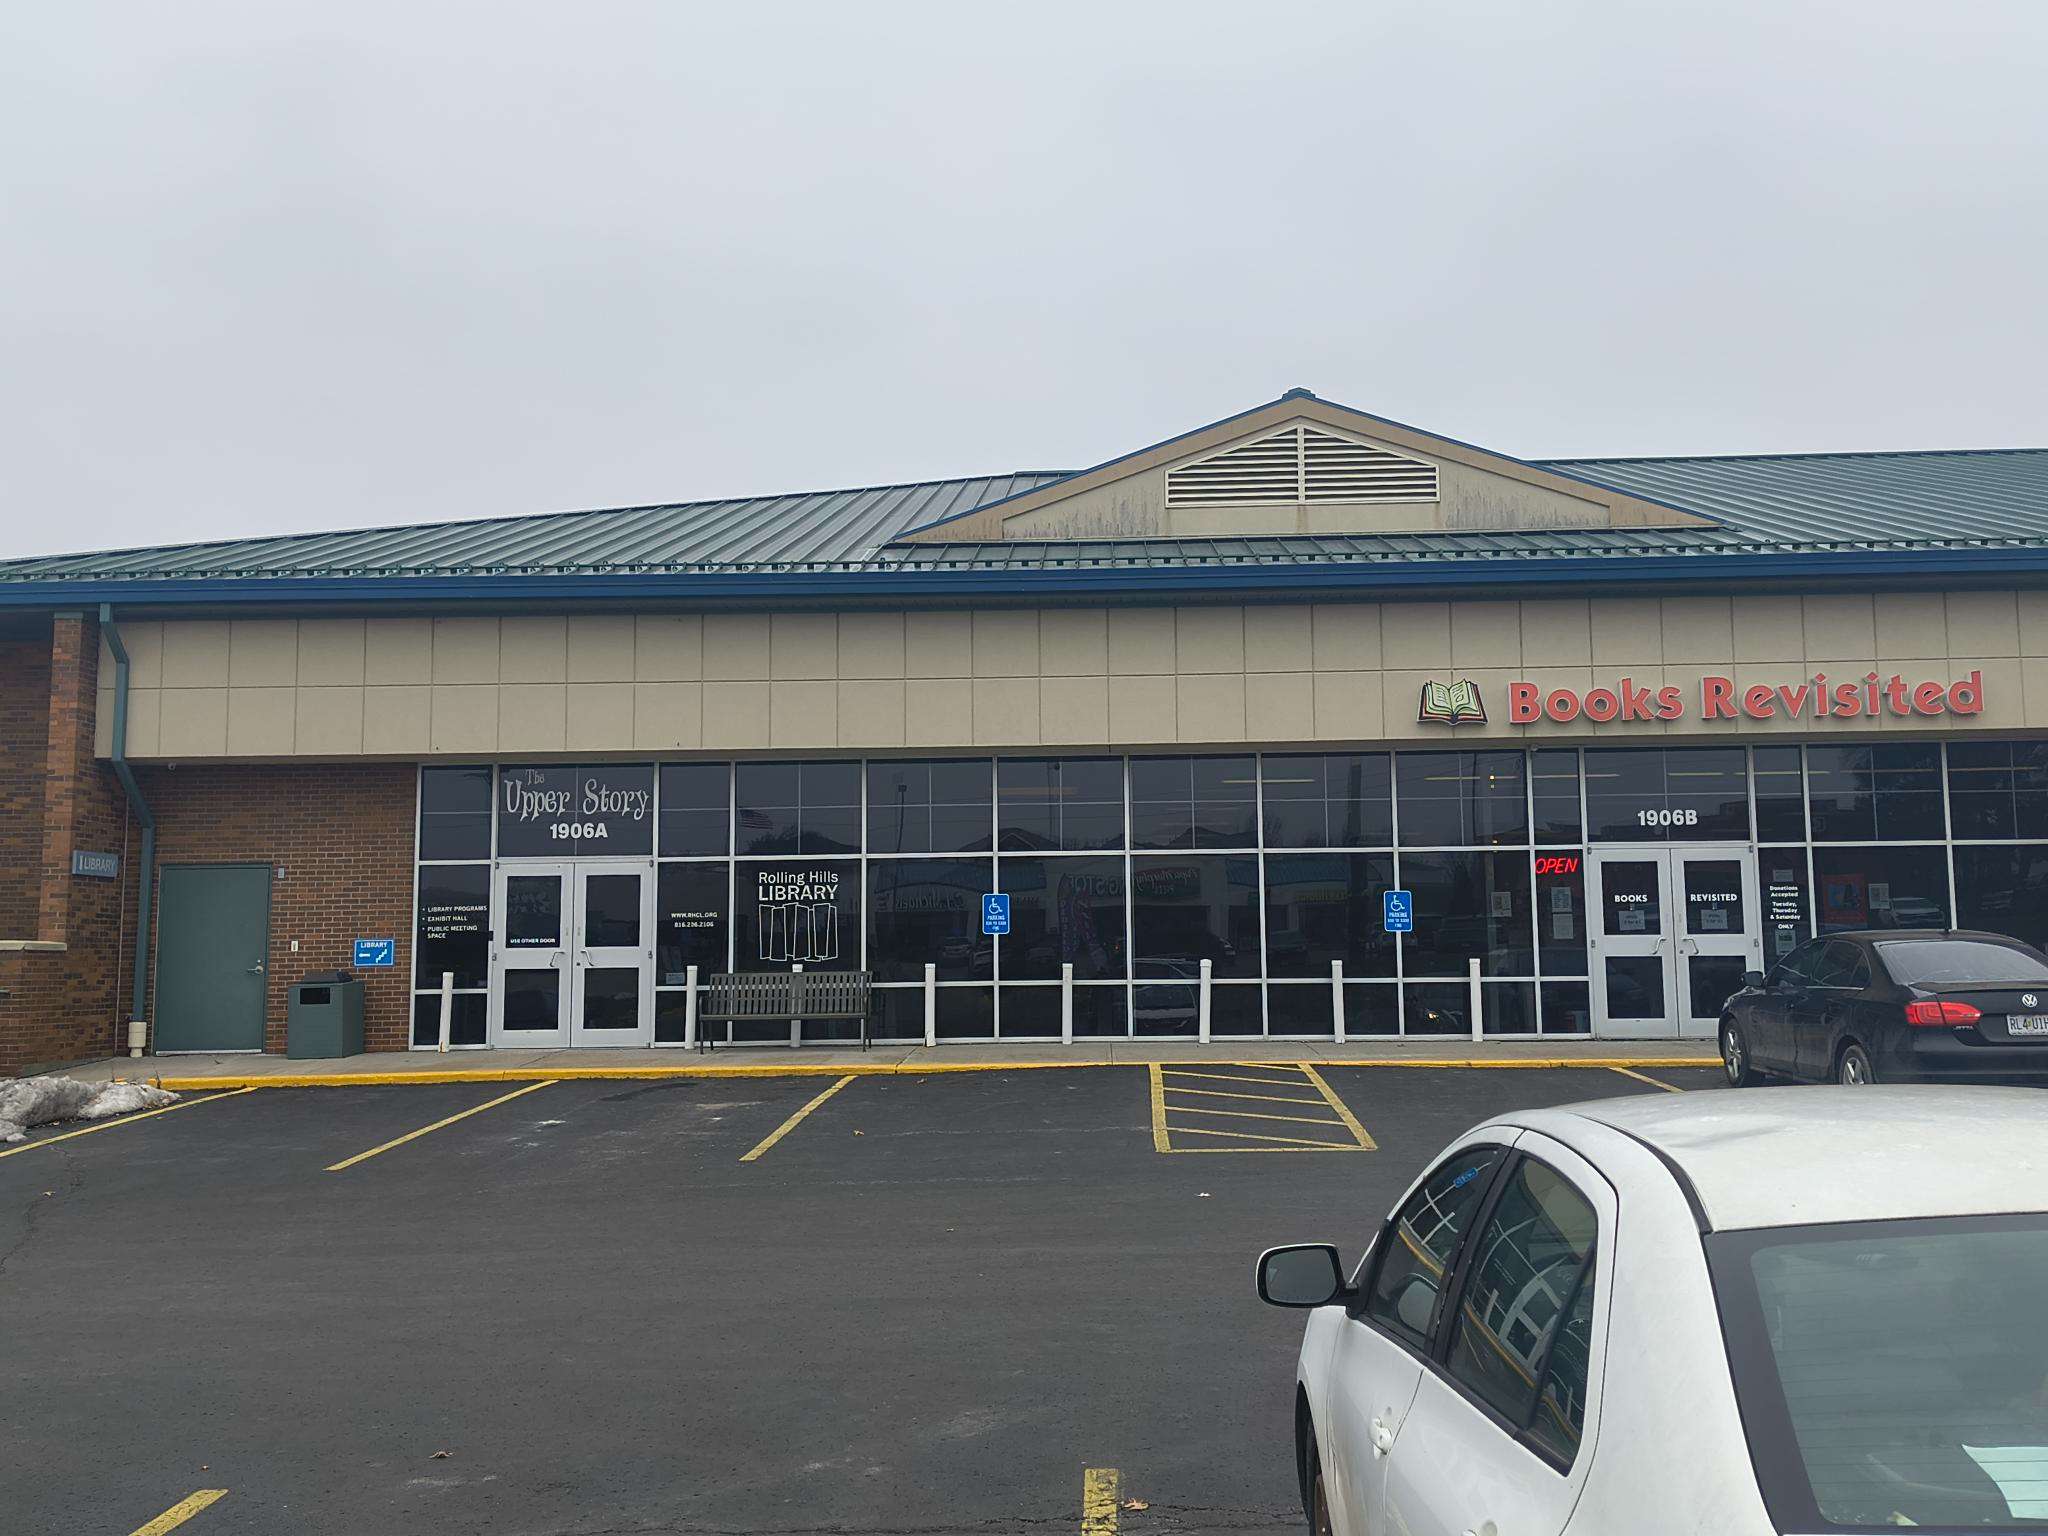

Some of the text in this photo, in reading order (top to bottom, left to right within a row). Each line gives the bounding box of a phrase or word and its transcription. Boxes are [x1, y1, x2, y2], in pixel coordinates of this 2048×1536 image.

[1509, 671, 1984, 725] Books Revisited
[504, 778, 650, 822] Upper Story
[1638, 809, 1698, 826] 1906B
[550, 822, 608, 839] 1906A
[84, 857, 115, 872] LIBRARY
[1535, 857, 1578, 874] OPEN
[759, 871, 839, 886] Rolling Hills
[758, 884, 839, 901] LIBRARY
[1614, 894, 1648, 903] BOOKS
[1690, 894, 1738, 902] REVISITED
